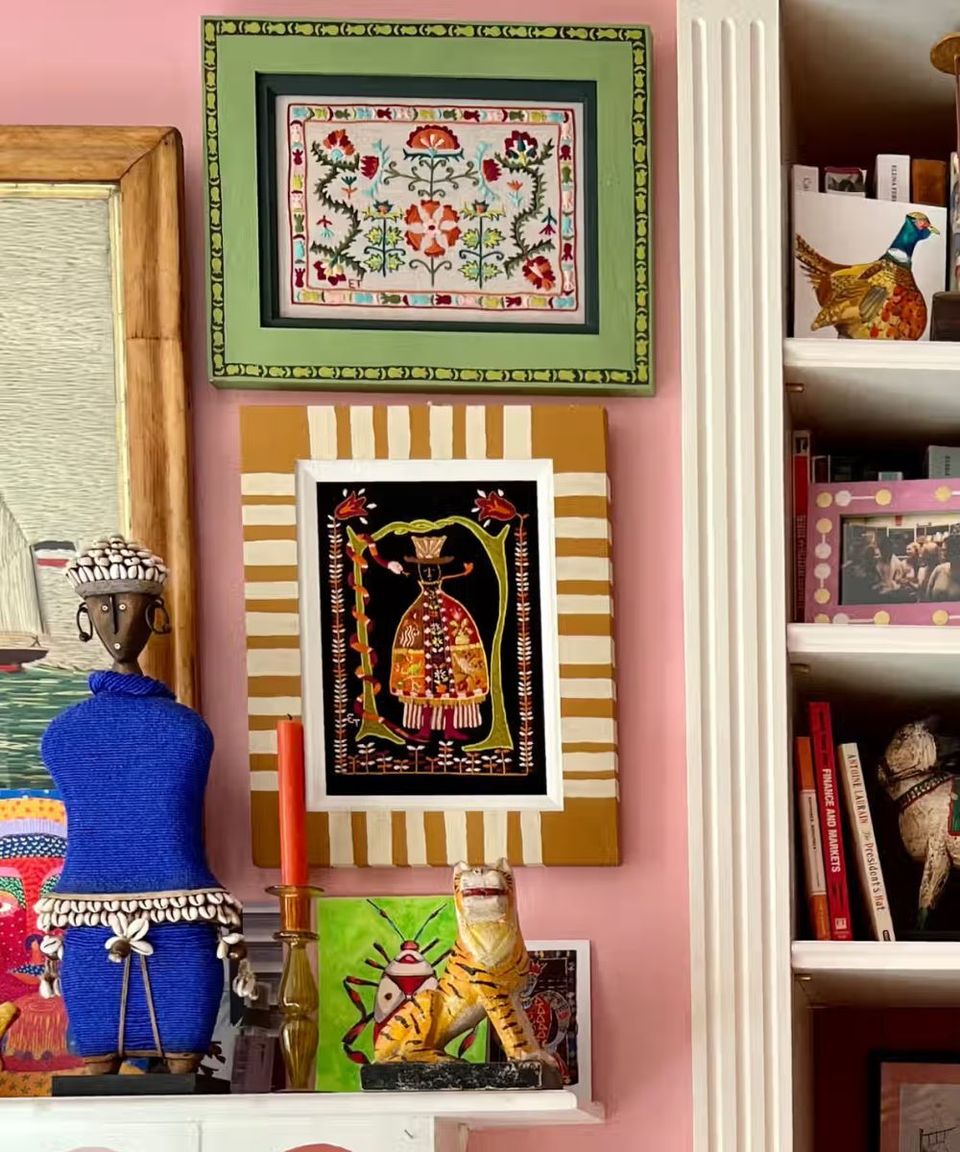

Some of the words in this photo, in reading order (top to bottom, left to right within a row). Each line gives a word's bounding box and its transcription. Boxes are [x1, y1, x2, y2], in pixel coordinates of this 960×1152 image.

[821, 768, 835, 807] FINANCE
[847, 754, 862, 791] ANTOINE
[825, 808, 836, 828] AND
[854, 790, 869, 825] LAURAIN
[827, 829, 841, 874] MARKETS
